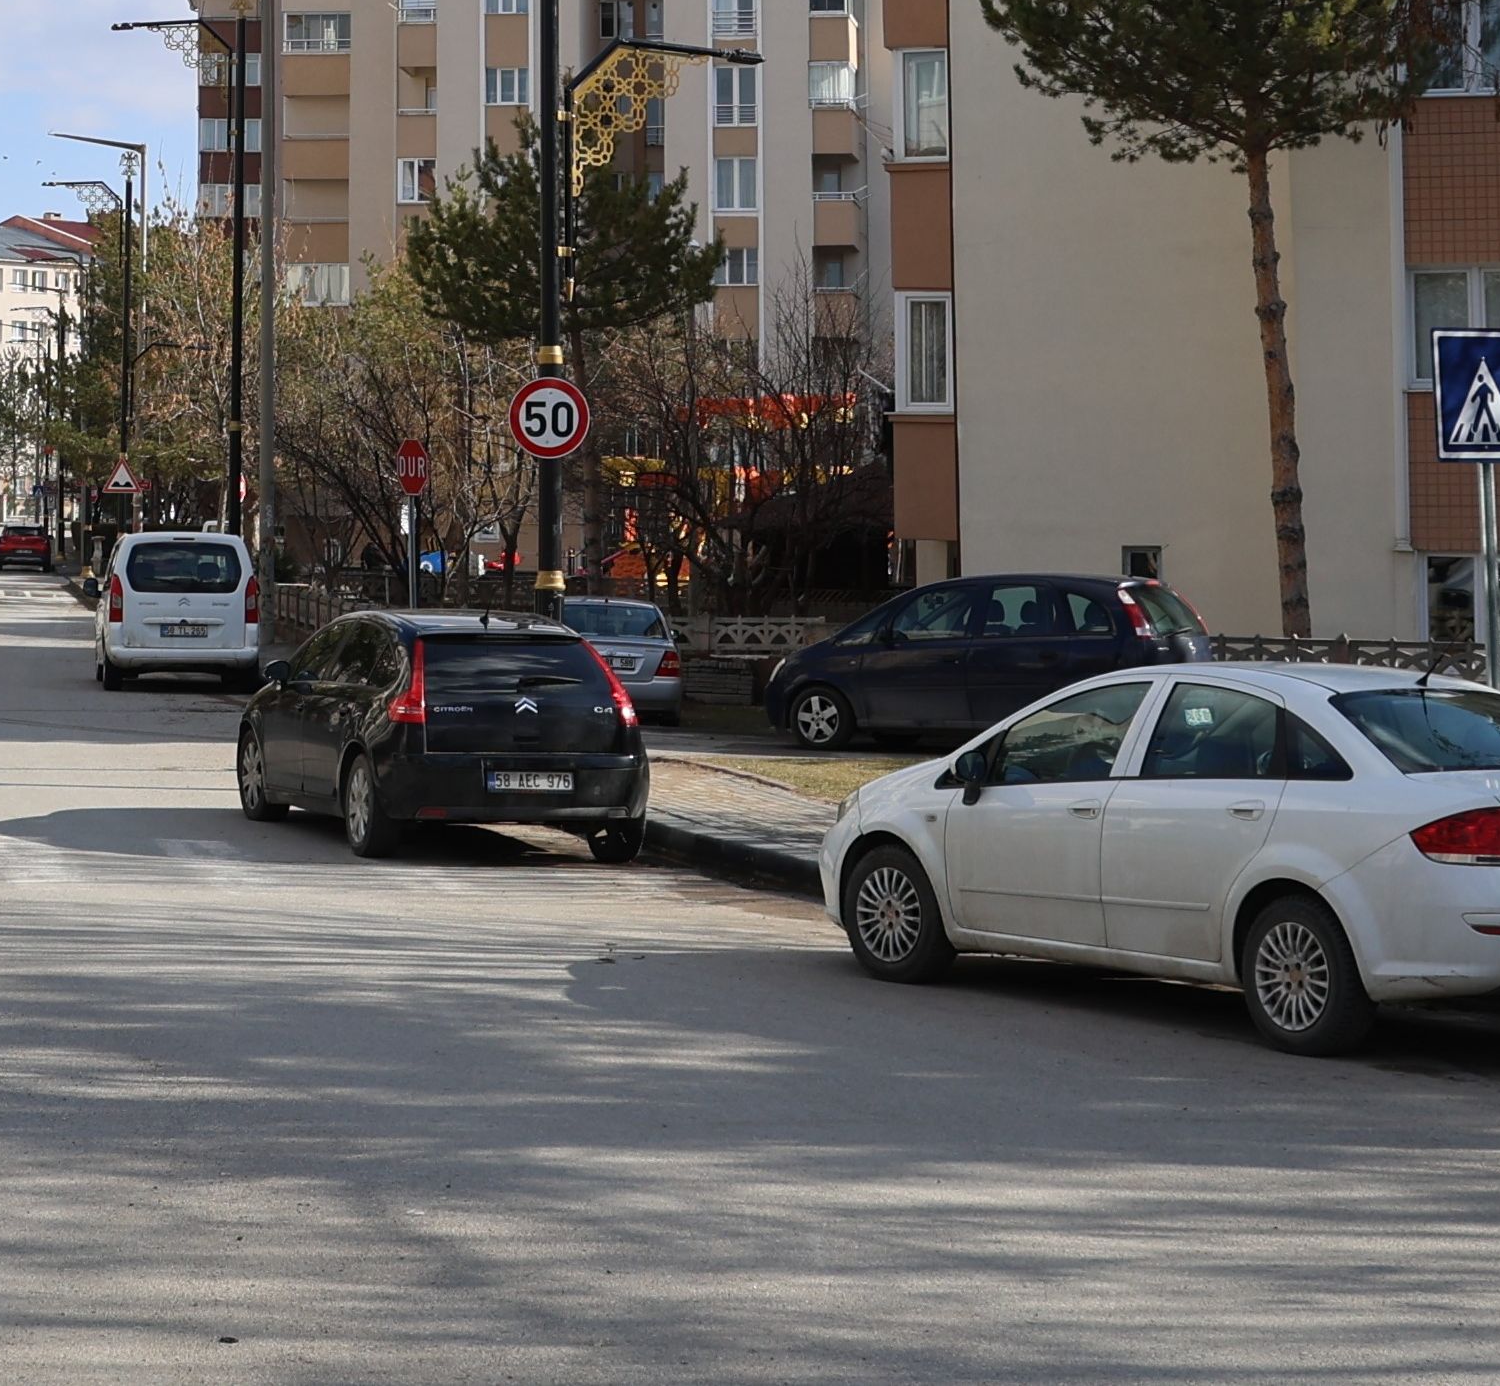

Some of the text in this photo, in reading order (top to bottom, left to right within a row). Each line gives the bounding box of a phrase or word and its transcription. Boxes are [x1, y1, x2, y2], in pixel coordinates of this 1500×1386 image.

[525, 401, 574, 437] 50
[400, 456, 426, 478] DUR
[594, 706, 613, 714] C4
[495, 774, 571, 788] 58 AEC 976
